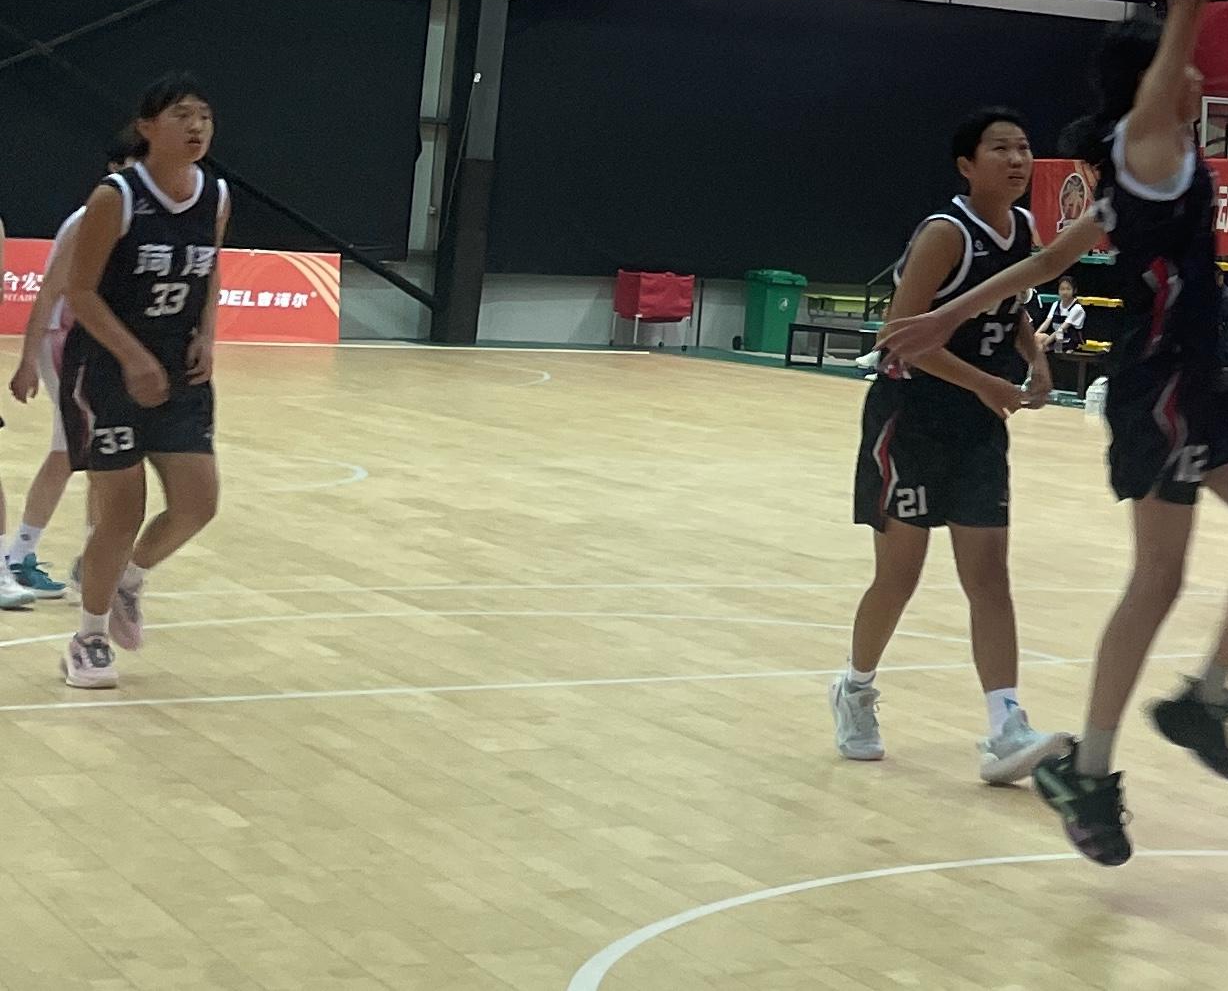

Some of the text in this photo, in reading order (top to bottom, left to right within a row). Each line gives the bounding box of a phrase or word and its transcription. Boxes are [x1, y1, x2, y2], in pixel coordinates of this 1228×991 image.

[144, 282, 191, 317] 33
[95, 426, 135, 454] 33
[895, 484, 929, 518] 21
